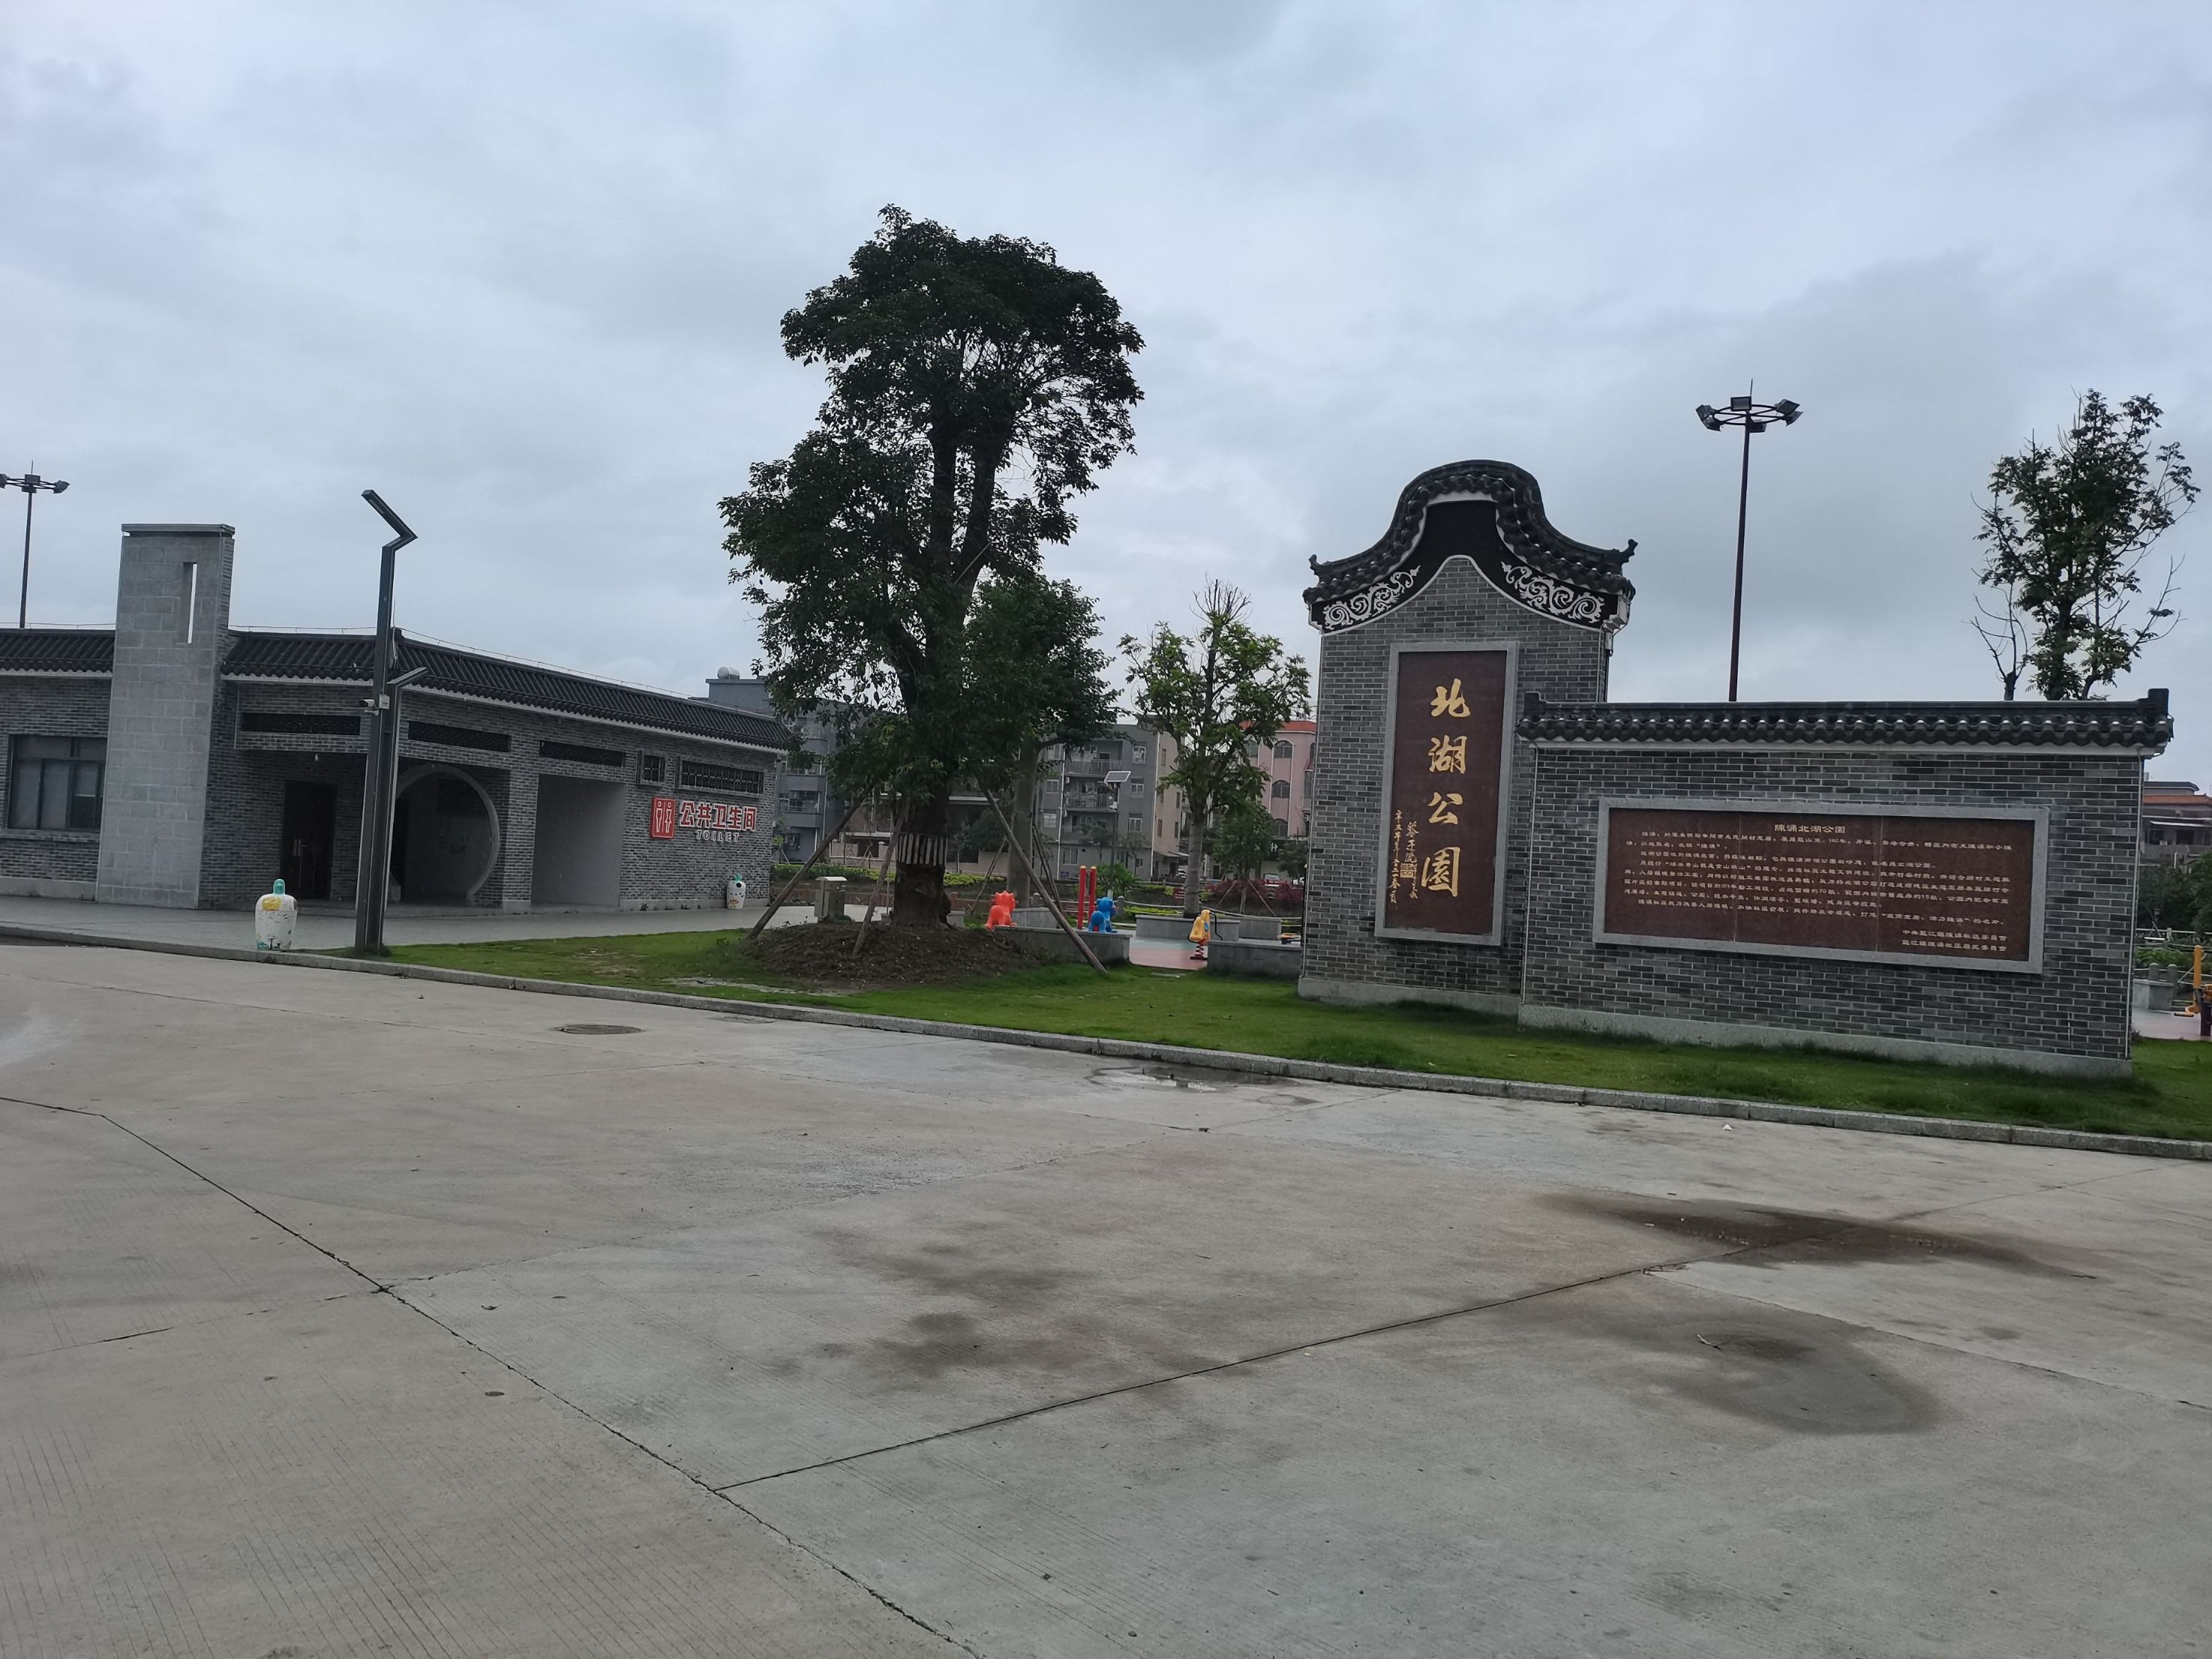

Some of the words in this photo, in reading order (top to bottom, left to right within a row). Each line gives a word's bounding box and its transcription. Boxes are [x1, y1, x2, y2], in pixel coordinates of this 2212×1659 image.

[1421, 678, 1470, 898] 北湖公園
[679, 800, 758, 832] 公共卫生间
[696, 830, 739, 842] TOILET
